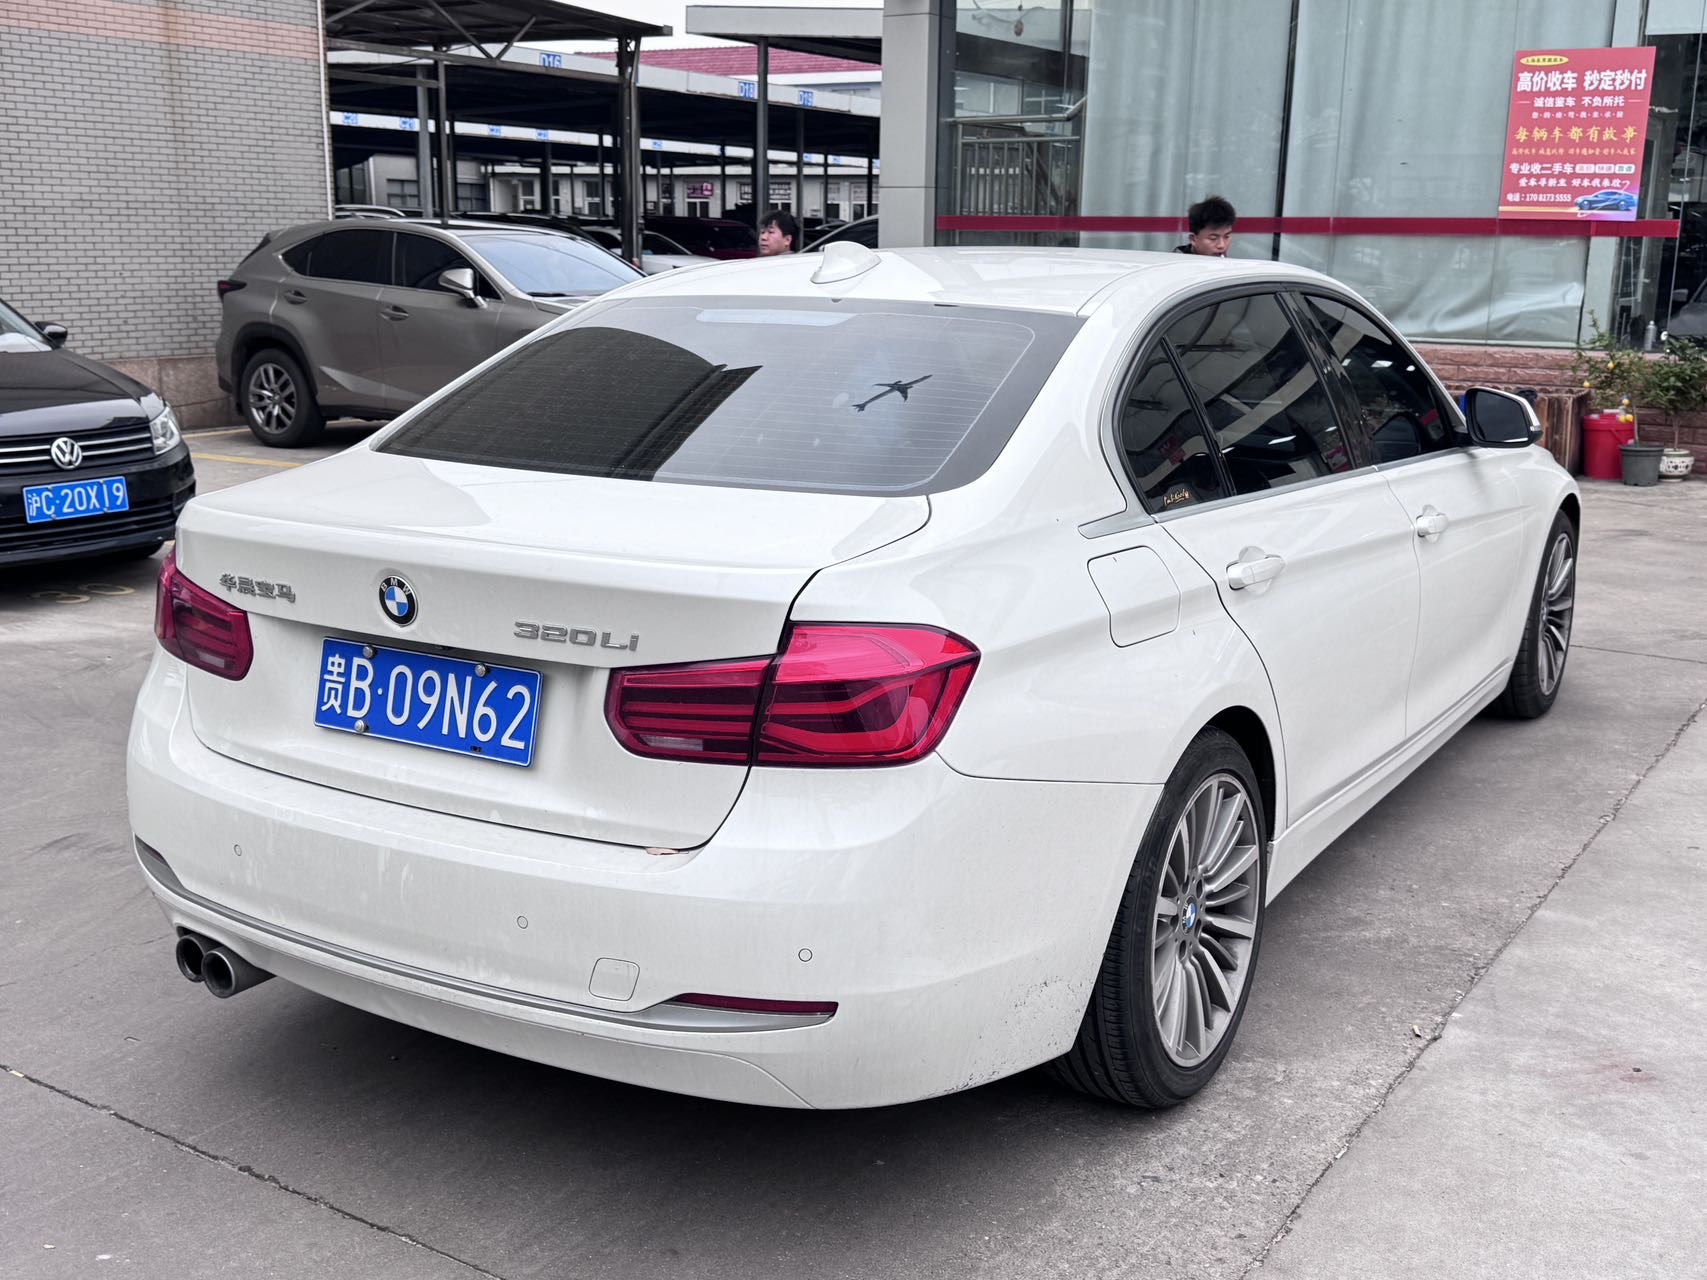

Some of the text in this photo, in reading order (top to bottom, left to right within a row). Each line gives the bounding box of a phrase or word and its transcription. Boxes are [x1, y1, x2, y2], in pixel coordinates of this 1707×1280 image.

[1517, 69, 1647, 92] 高价收车 秒定秒付
[1581, 96, 1625, 107] 不负所托
[1514, 126, 1638, 143] 每辆车都有故事
[1509, 163, 1574, 175] 专业收二手车
[27, 482, 124, 517] 沪C·20X19
[219, 572, 297, 603] 华晨宝马
[380, 577, 412, 596] BMW
[513, 621, 640, 652] 320Li
[321, 653, 531, 750] 贵B·09N62
